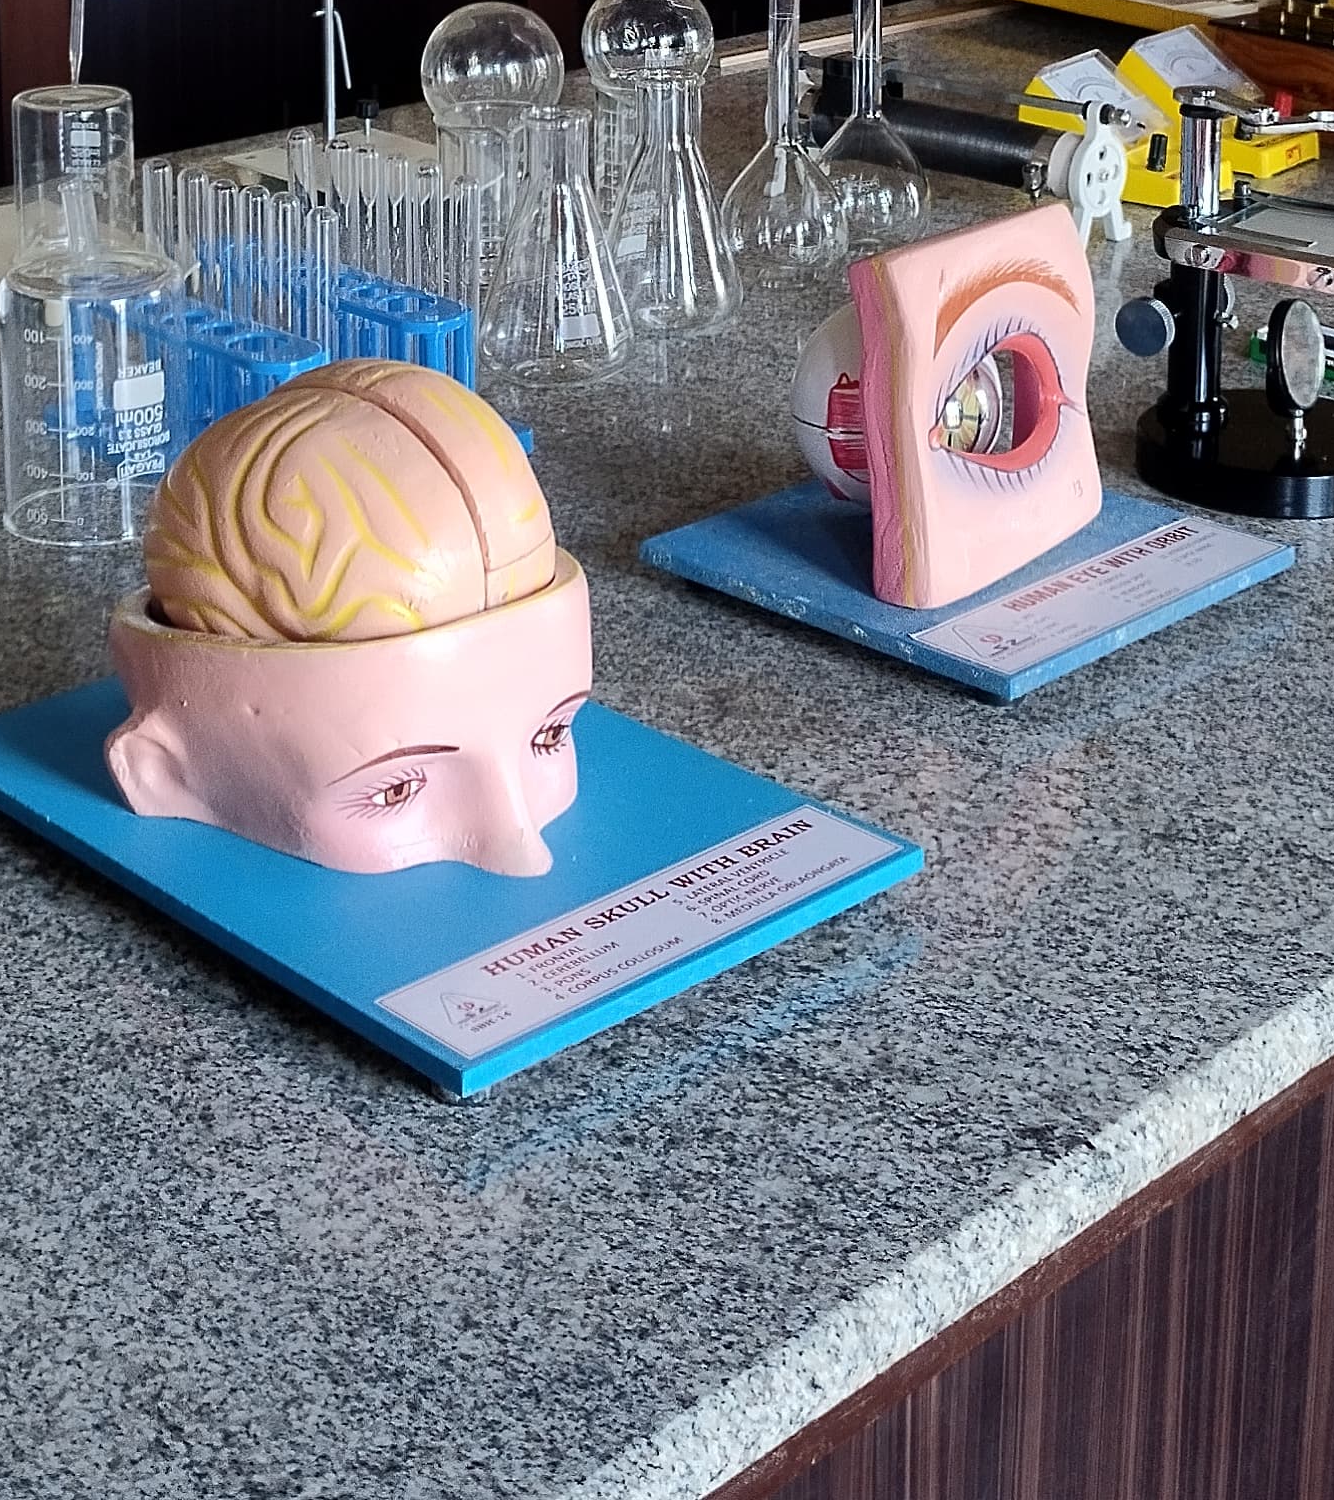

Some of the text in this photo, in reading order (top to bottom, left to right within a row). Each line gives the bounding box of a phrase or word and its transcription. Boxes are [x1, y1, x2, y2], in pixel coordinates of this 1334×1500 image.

[24, 328, 46, 344] 100
[73, 334, 94, 345] 400
[118, 357, 163, 379] BEAKER
[24, 374, 48, 390] 200
[115, 403, 164, 428] 500ml
[106, 429, 172, 456] BOROSILICATE
[133, 422, 163, 438] GLASS
[26, 463, 48, 479] 400
[75, 471, 95, 481] 100
[119, 457, 165, 478] PRAGATI
[1002, 578, 1075, 613] HUMAN
[1069, 565, 1110, 584] EYE
[1105, 546, 1154, 569] WITH
[1145, 525, 1201, 550] ORBIT
[685, 878, 736, 902] LATERAL
[730, 848, 790, 879] VENTRICLE
[697, 886, 740, 907] SPINAL
[737, 869, 771, 890] CORD
[480, 818, 814, 977] HUMAN SKULL WITH BRAIN
[710, 892, 749, 914] OPTIC
[745, 876, 782, 897] NERVE
[724, 890, 781, 921] MEDULLA
[529, 943, 588, 974] FRONTAL
[542, 940, 621, 981] CEREBELLUM
[566, 969, 619, 995] CORPUS
[616, 935, 684, 971] COLLOSUM
[554, 967, 592, 988] PONS
